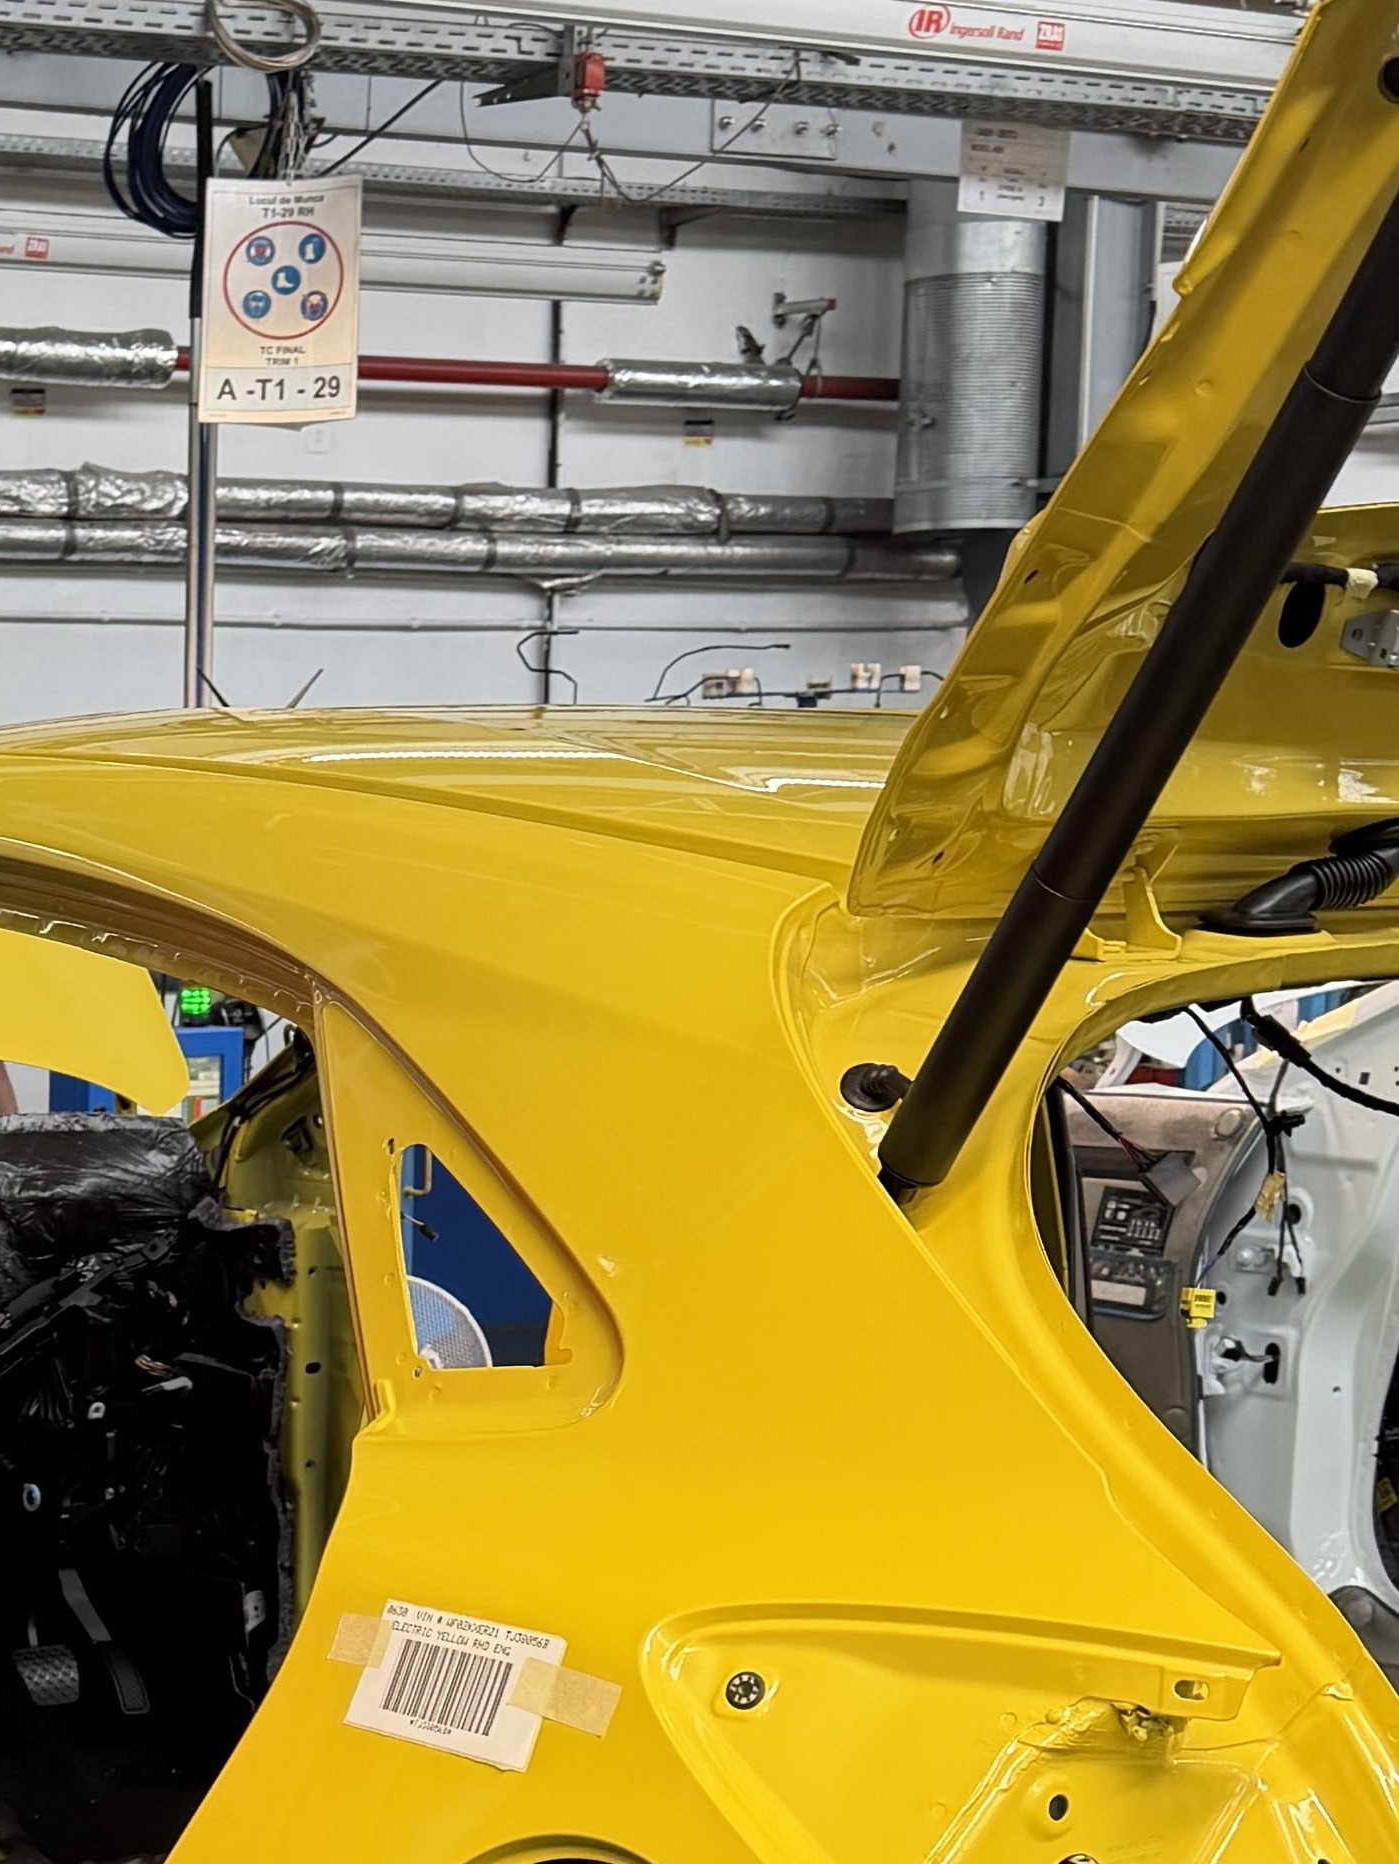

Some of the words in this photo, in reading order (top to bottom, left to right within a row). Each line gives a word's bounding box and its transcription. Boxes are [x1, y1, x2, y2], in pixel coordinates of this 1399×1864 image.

[915, 9, 944, 33] IR
[949, 23, 996, 39] Ingersoll
[997, 26, 1024, 41] Rand
[262, 208, 294, 218] T1-29
[298, 207, 314, 217] RH
[260, 346, 273, 354] TC
[276, 346, 306, 354] FINAL
[265, 357, 290, 366] TRIM
[217, 378, 236, 400] A
[313, 376, 340, 398] 29
[416, 1610, 434, 1622] VIN
[392, 1620, 433, 1638] ELECTRIC
[437, 1631, 470, 1646] YELLOW
[493, 1643, 512, 1656] ENG
